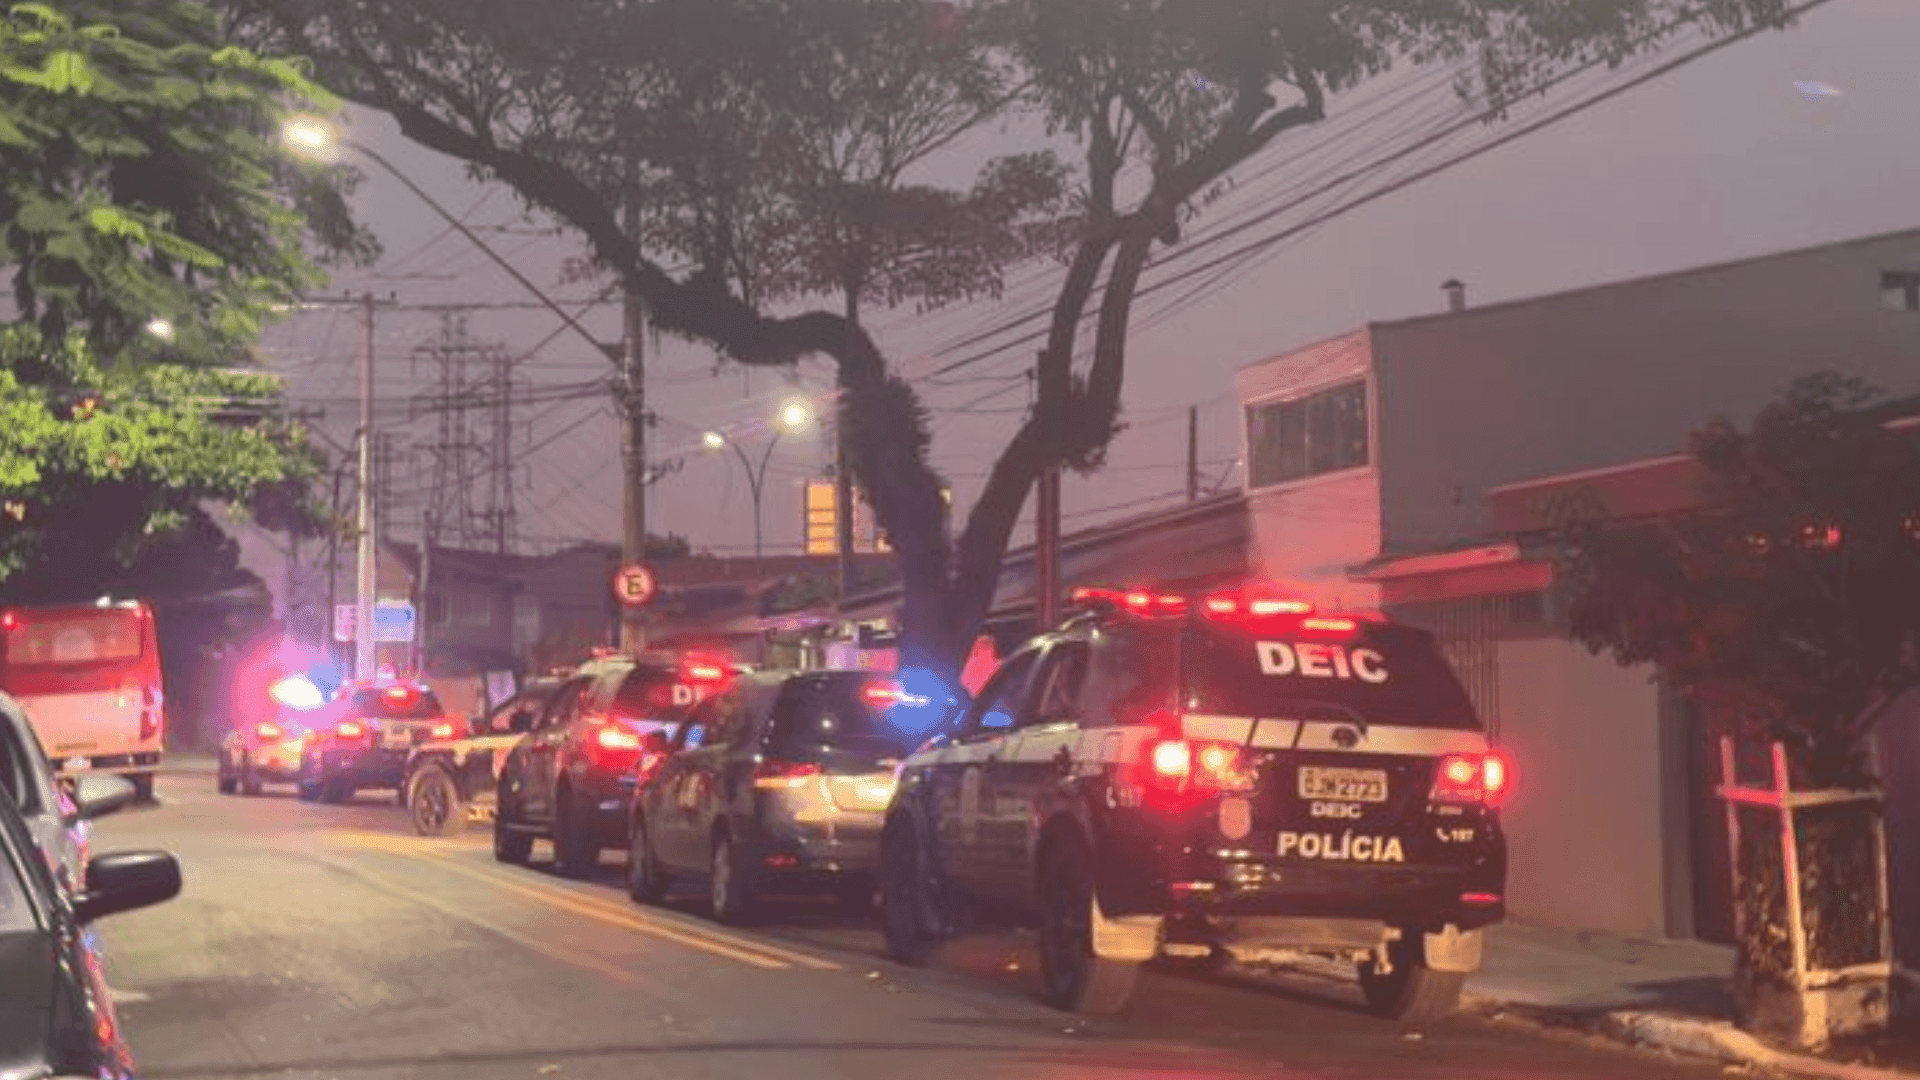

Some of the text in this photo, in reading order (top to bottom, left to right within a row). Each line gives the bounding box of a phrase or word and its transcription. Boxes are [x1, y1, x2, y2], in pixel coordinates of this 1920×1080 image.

[625, 574, 643, 595] E
[1255, 640, 1388, 683] DEIC
[1310, 801, 1362, 819] DEIC
[1277, 828, 1404, 862] POLÍCIA
